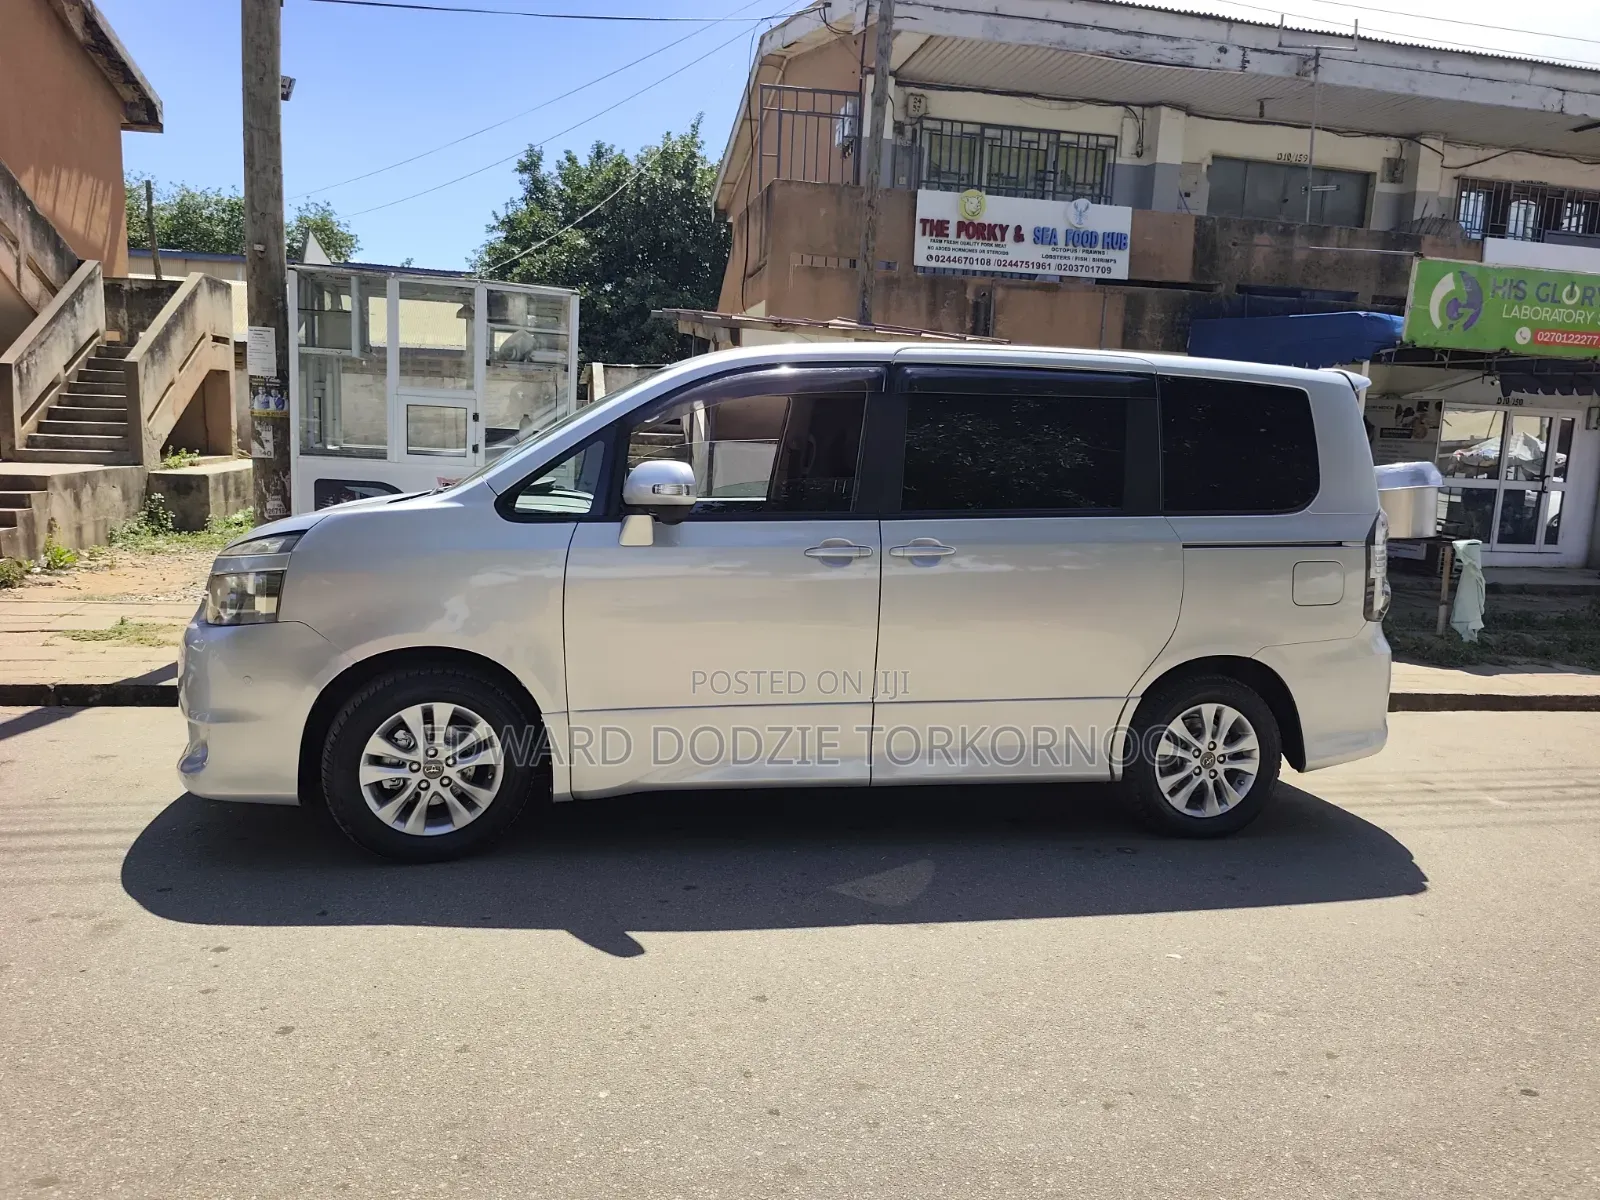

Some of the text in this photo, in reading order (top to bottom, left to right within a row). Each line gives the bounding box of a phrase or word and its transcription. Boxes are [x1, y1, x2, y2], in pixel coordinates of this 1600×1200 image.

[919, 218, 1128, 251] THE PORKY & SEA FOOD HUB
[934, 254, 991, 266] 0244670108
[1490, 276, 1600, 307] HIS GLOR
[1502, 304, 1595, 325] LABORATORY
